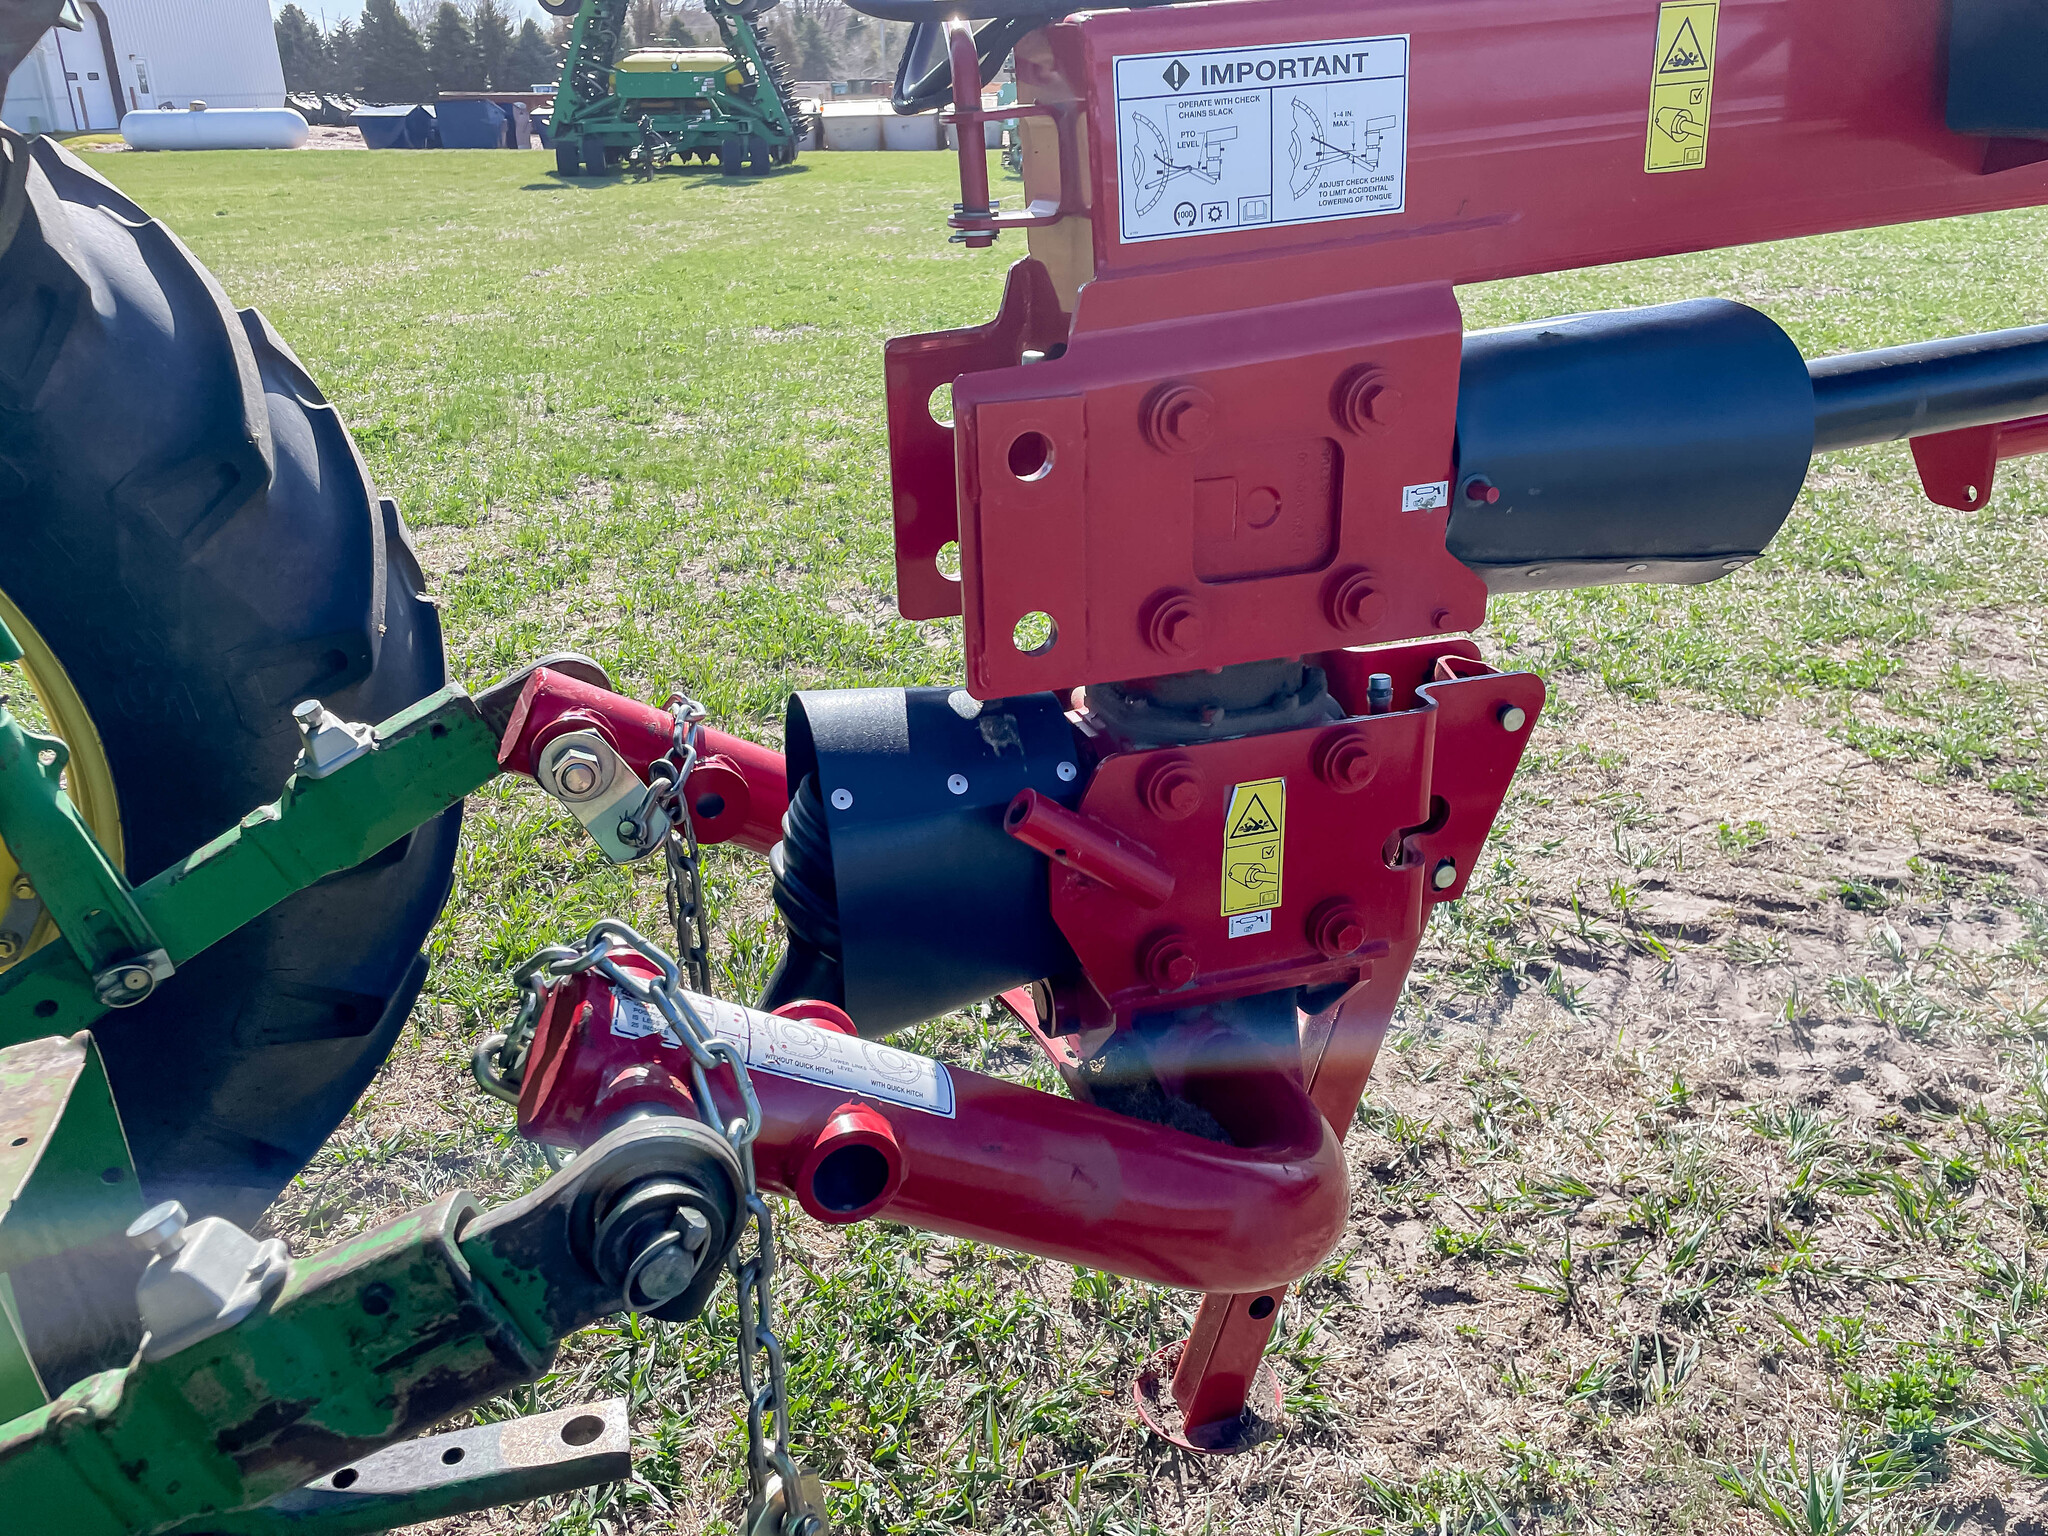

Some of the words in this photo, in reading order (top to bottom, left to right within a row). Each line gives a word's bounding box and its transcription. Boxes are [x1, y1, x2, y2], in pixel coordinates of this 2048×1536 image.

[1201, 52, 1369, 86] IMPORTANT
[1178, 99, 1212, 109] OPERATE
[1213, 97, 1233, 106] WITH
[1234, 95, 1261, 104] CHECK
[1178, 110, 1207, 119] CHAINS
[1208, 108, 1233, 117] SLACK
[1332, 120, 1349, 128] MAX.
[1180, 130, 1196, 138] PTO
[1177, 140, 1200, 149] LEVEL
[1318, 180, 1344, 189] ADJUST
[1345, 177, 1369, 186] CHECK
[1369, 174, 1395, 184] CHAINS
[1318, 190, 1328, 198] TO
[1329, 188, 1347, 197] LIMIT
[1348, 184, 1388, 195] ACCIDENTAL
[1318, 197, 1353, 207] LOWERING
[1354, 195, 1364, 203] OF
[1365, 192, 1392, 202] TONGUE
[1177, 210, 1193, 219] 1000
[764, 1052, 794, 1065] WITHOUT
[794, 1060, 814, 1070] QUICK
[815, 1065, 834, 1075] HITCH
[870, 1079, 886, 1089] WITH
[886, 1083, 906, 1094] QUICK
[906, 1088, 924, 1098] HITCH
